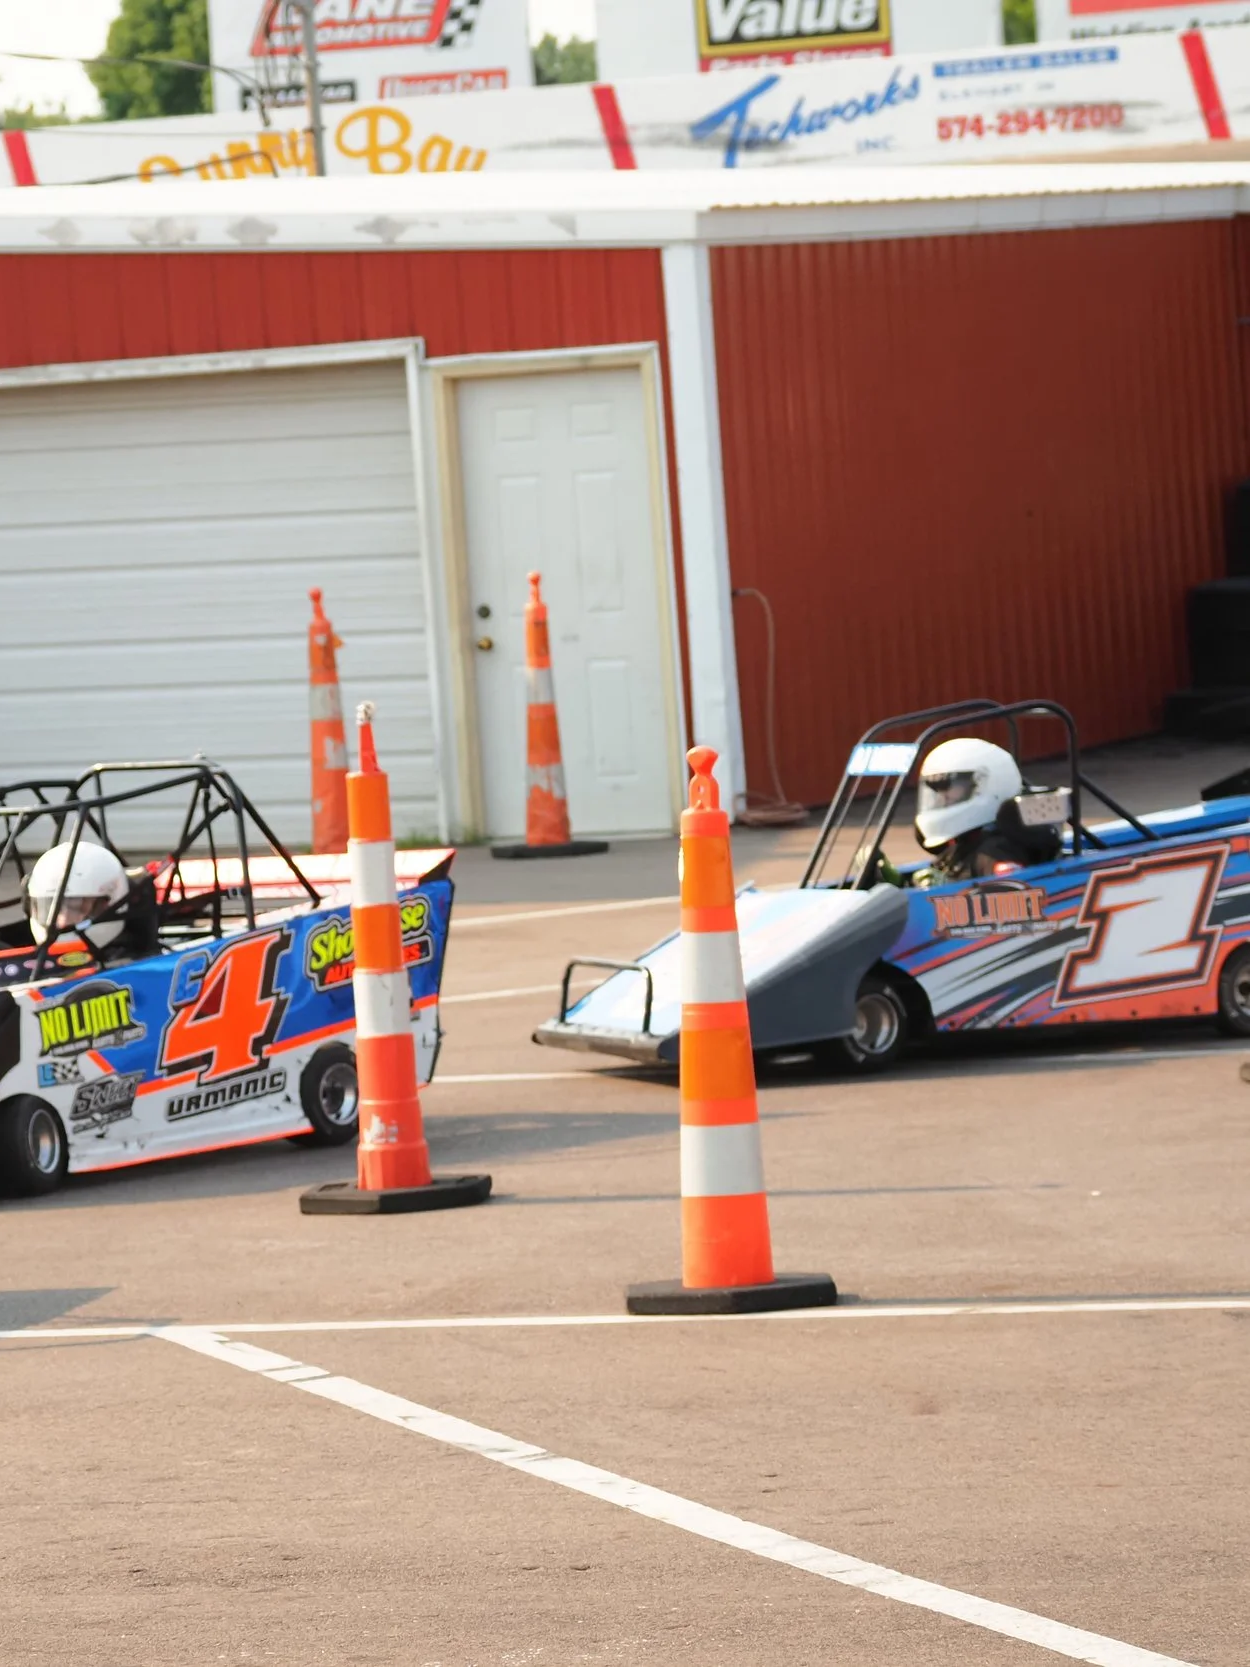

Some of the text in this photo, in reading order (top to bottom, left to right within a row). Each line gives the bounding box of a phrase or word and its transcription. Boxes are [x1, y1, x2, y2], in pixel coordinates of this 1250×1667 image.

[936, 102, 1125, 141] 574-294-7200
[933, 887, 1045, 933] NO LIMIT
[1058, 851, 1224, 1002] 1
[39, 1006, 70, 1052] NO
[69, 989, 131, 1039] LIMIT
[167, 1071, 286, 1118] URMANIC
